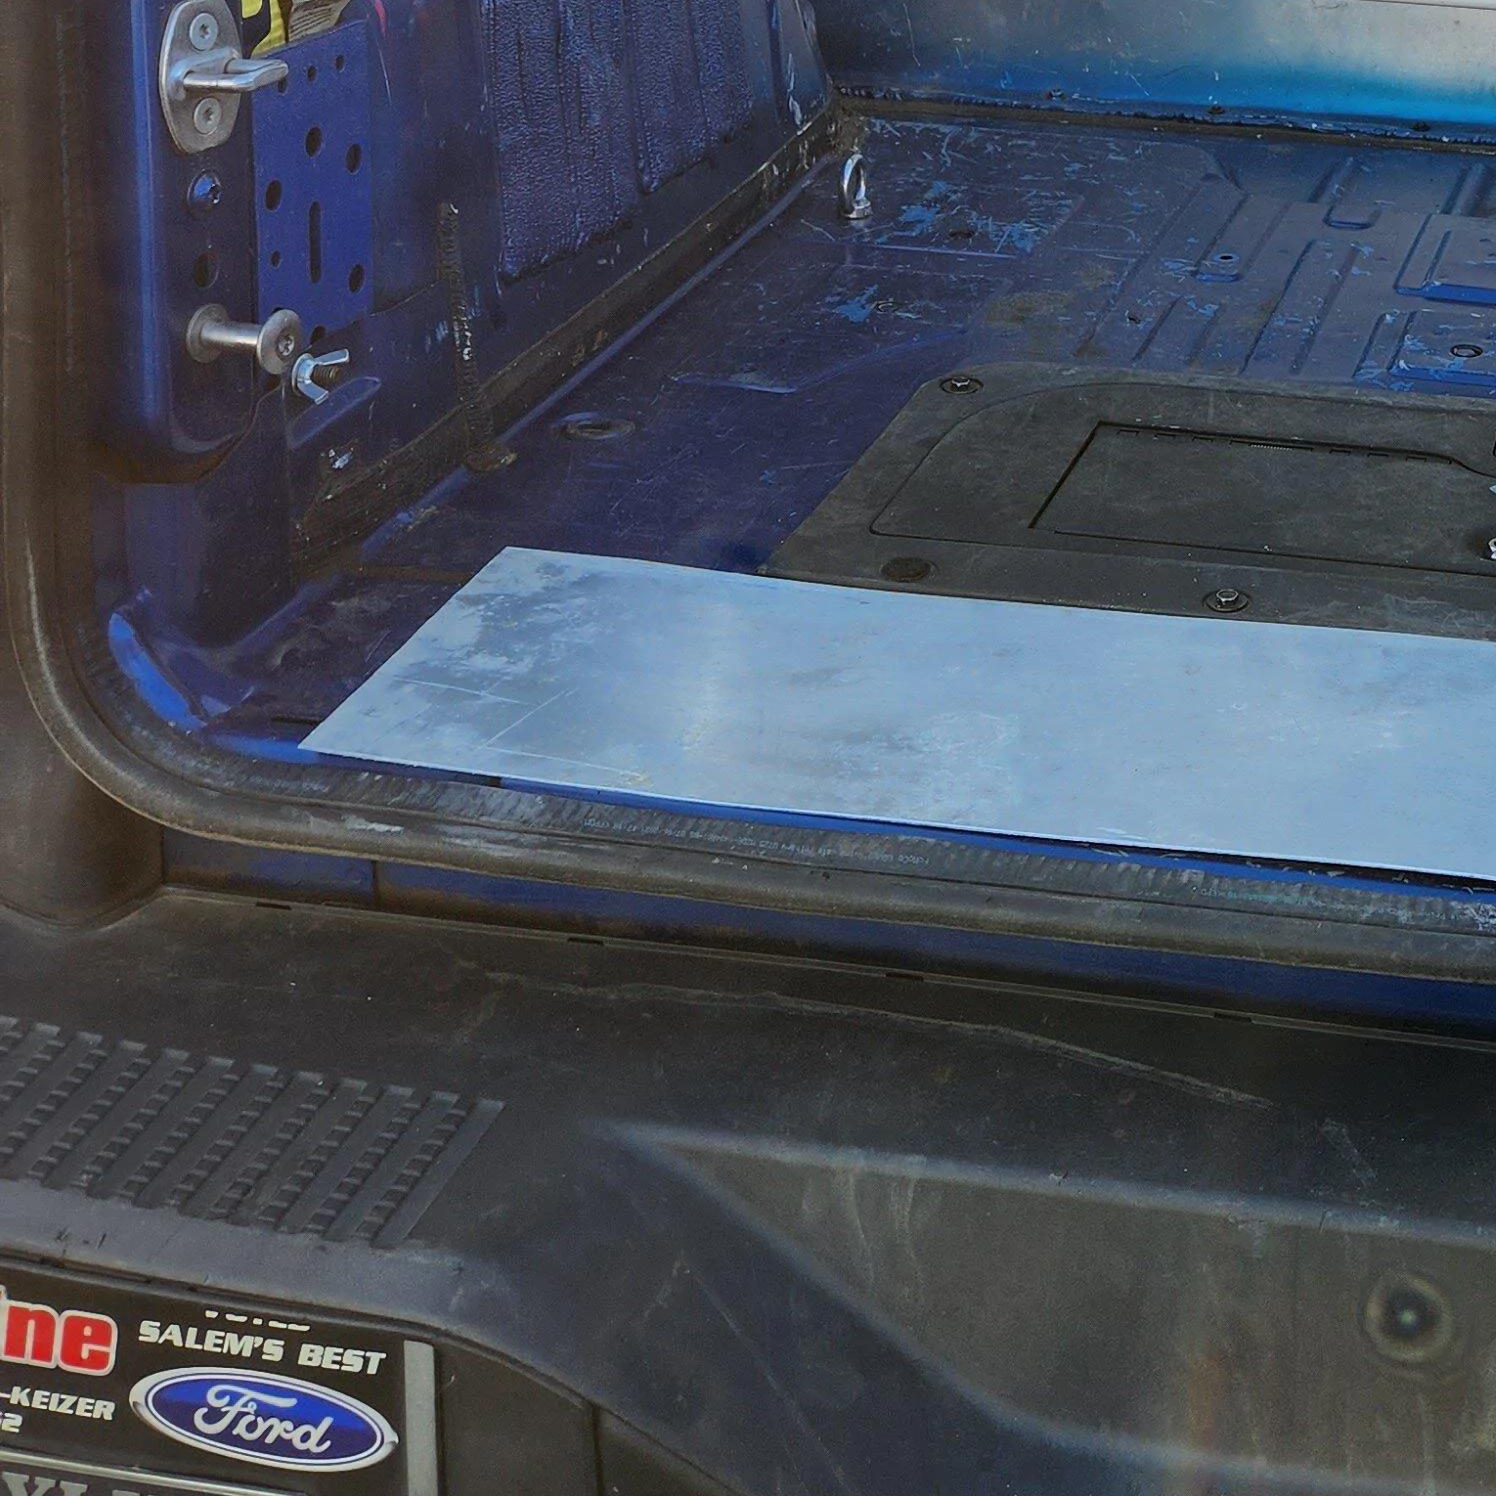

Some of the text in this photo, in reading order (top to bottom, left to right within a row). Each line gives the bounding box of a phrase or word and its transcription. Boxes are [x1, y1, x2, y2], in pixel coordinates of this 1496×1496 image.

[0, 1300, 117, 1376] ne
[138, 1320, 285, 1362] SALEM'S
[298, 1343, 387, 1375] BEST
[193, 1385, 334, 1453] Ford
